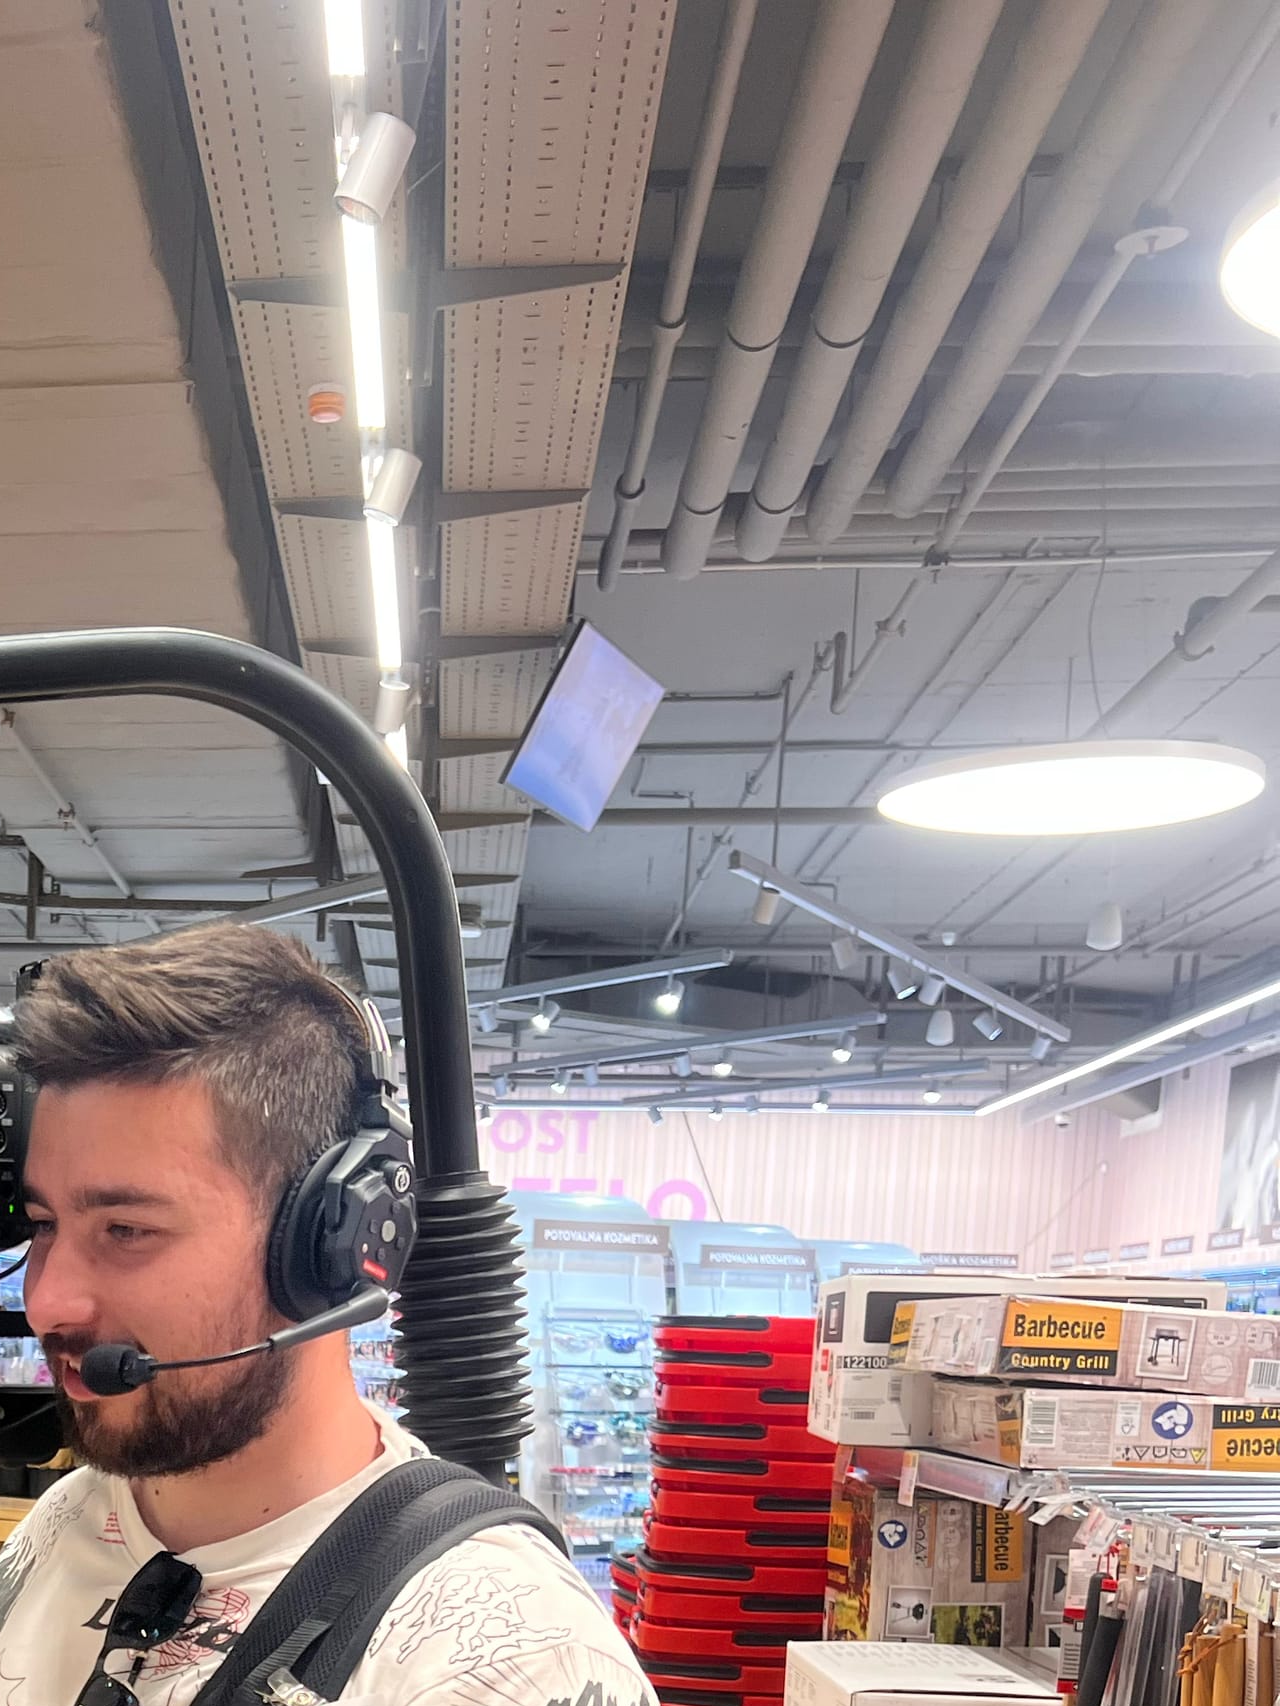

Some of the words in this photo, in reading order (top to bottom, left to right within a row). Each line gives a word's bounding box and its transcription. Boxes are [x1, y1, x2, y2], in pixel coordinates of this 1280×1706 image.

[491, 1109, 600, 1154] OST
[544, 1228, 602, 1244] POTOVALNA
[603, 1231, 659, 1247] KOZMETIKA
[709, 1252, 759, 1265] POTOVALNA
[759, 1254, 807, 1267] KOZMETIKA
[959, 1256, 1017, 1267] KOZMETIKA
[1013, 1314, 1106, 1340] Barbecue
[1011, 1352, 1071, 1370] Country
[1076, 1354, 1110, 1370] Grill
